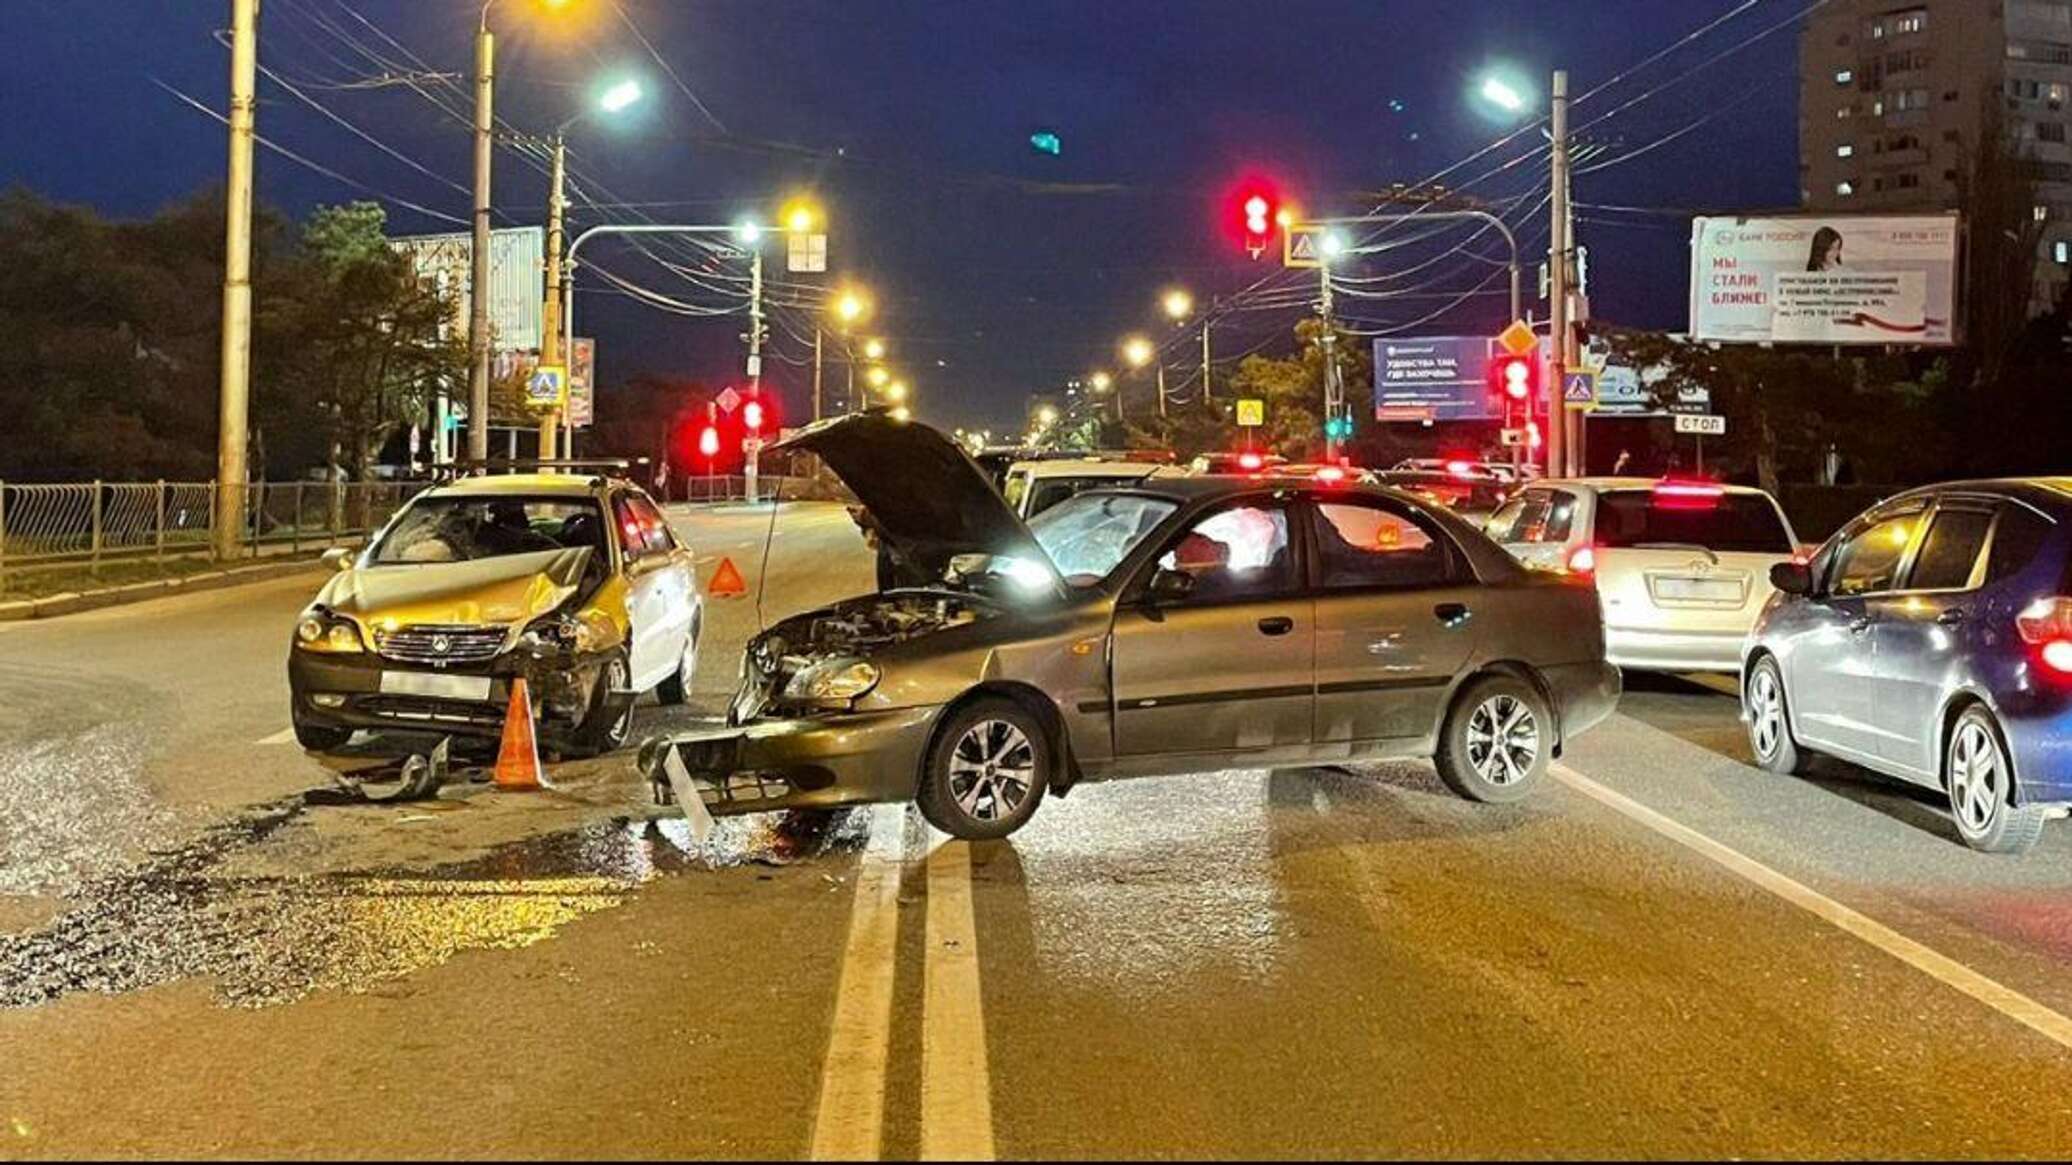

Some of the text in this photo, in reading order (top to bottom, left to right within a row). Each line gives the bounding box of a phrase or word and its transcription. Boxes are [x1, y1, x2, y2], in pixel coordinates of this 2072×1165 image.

[1713, 257, 1737, 268] МЫ
[1713, 275, 1757, 286] СТАЛИ
[1712, 292, 1767, 304] БЛИЖЕ!
[1681, 417, 1720, 430] СТОП
